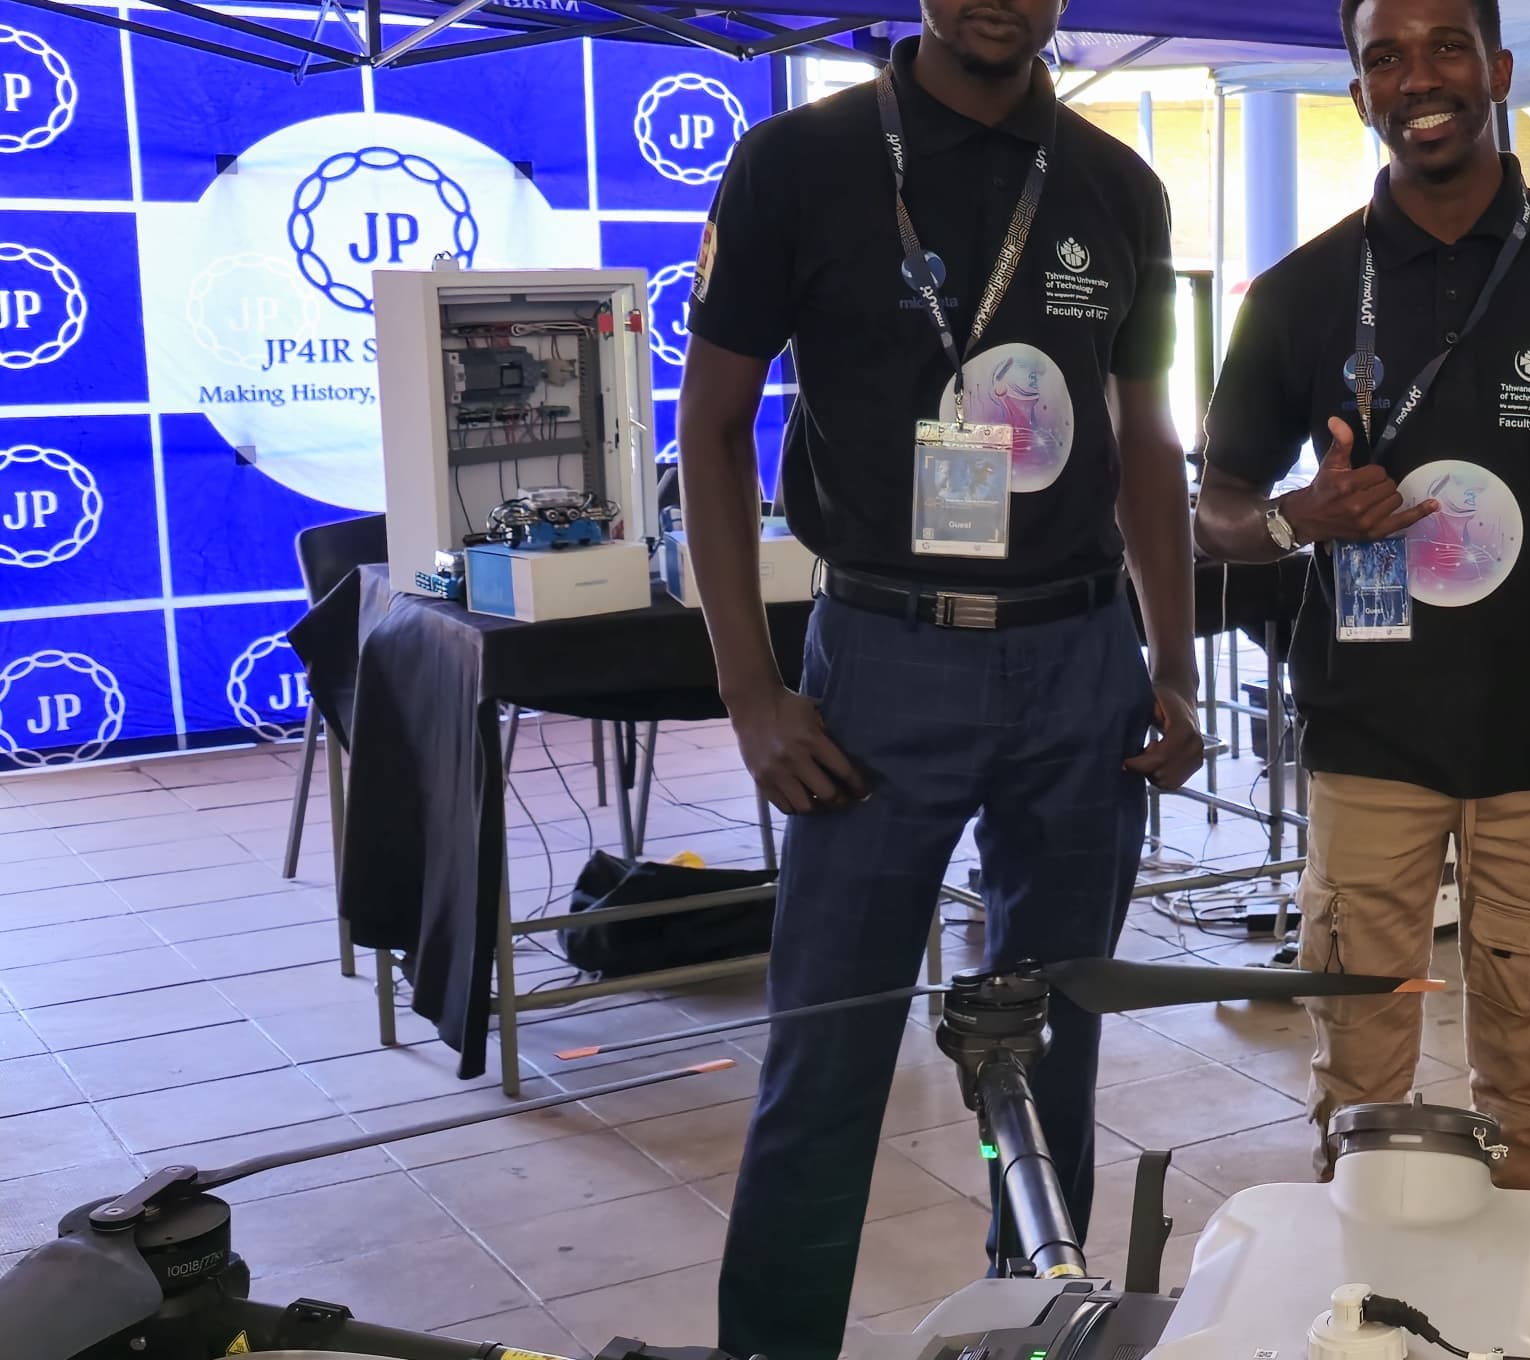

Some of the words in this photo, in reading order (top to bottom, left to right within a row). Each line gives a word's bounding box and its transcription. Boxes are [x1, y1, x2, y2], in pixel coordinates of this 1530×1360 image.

[669, 115, 715, 149] JP
[349, 212, 419, 264] JP
[1045, 271, 1076, 283] Tshwane
[1076, 276, 1109, 289] University
[1055, 281, 1094, 295] Technology
[1046, 305, 1083, 319] Faculty
[1085, 308, 1095, 318] of
[1095, 309, 1109, 320] ICT
[261, 338, 354, 372] JP4IR
[199, 384, 286, 407] Making
[291, 383, 376, 405] History,
[1500, 392, 1509, 400] of
[3, 491, 58, 530] JP
[27, 695, 82, 735] JP
